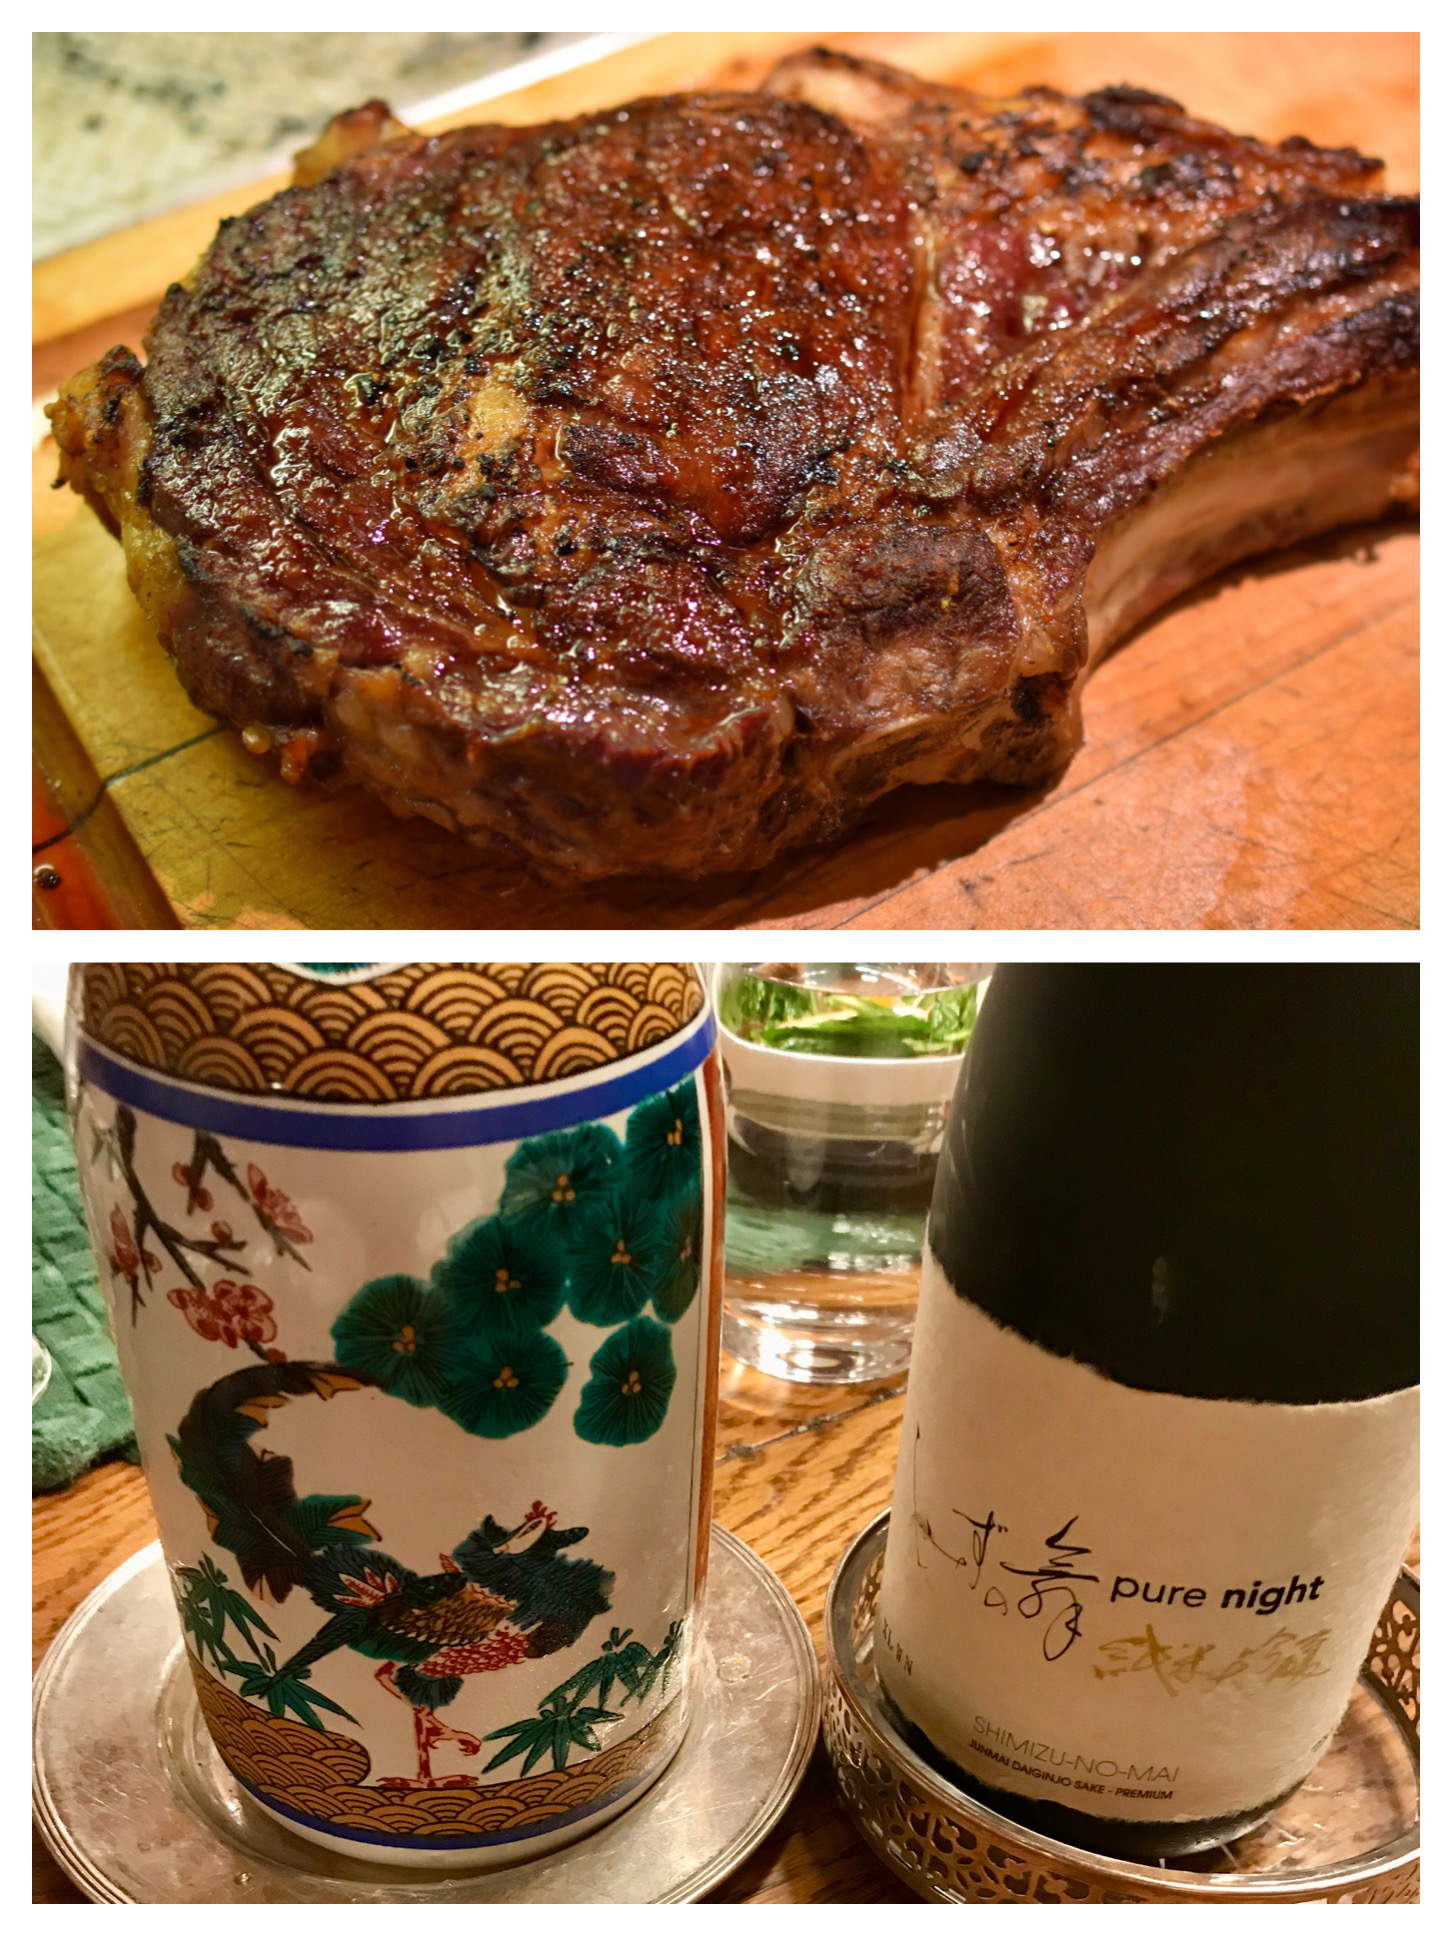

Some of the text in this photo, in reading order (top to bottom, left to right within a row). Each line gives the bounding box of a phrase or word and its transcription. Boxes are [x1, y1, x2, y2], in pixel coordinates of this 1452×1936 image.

[1110, 1574, 1325, 1616] pure night
[968, 1738, 1009, 1767] JUNMAI
[1011, 1760, 1072, 1787] DAIGINJO
[1074, 1780, 1106, 1794] SAKE
[1114, 1786, 1174, 1800] PREMIUM
[972, 1714, 1180, 1783] SHIMIZU-NO-MAI
